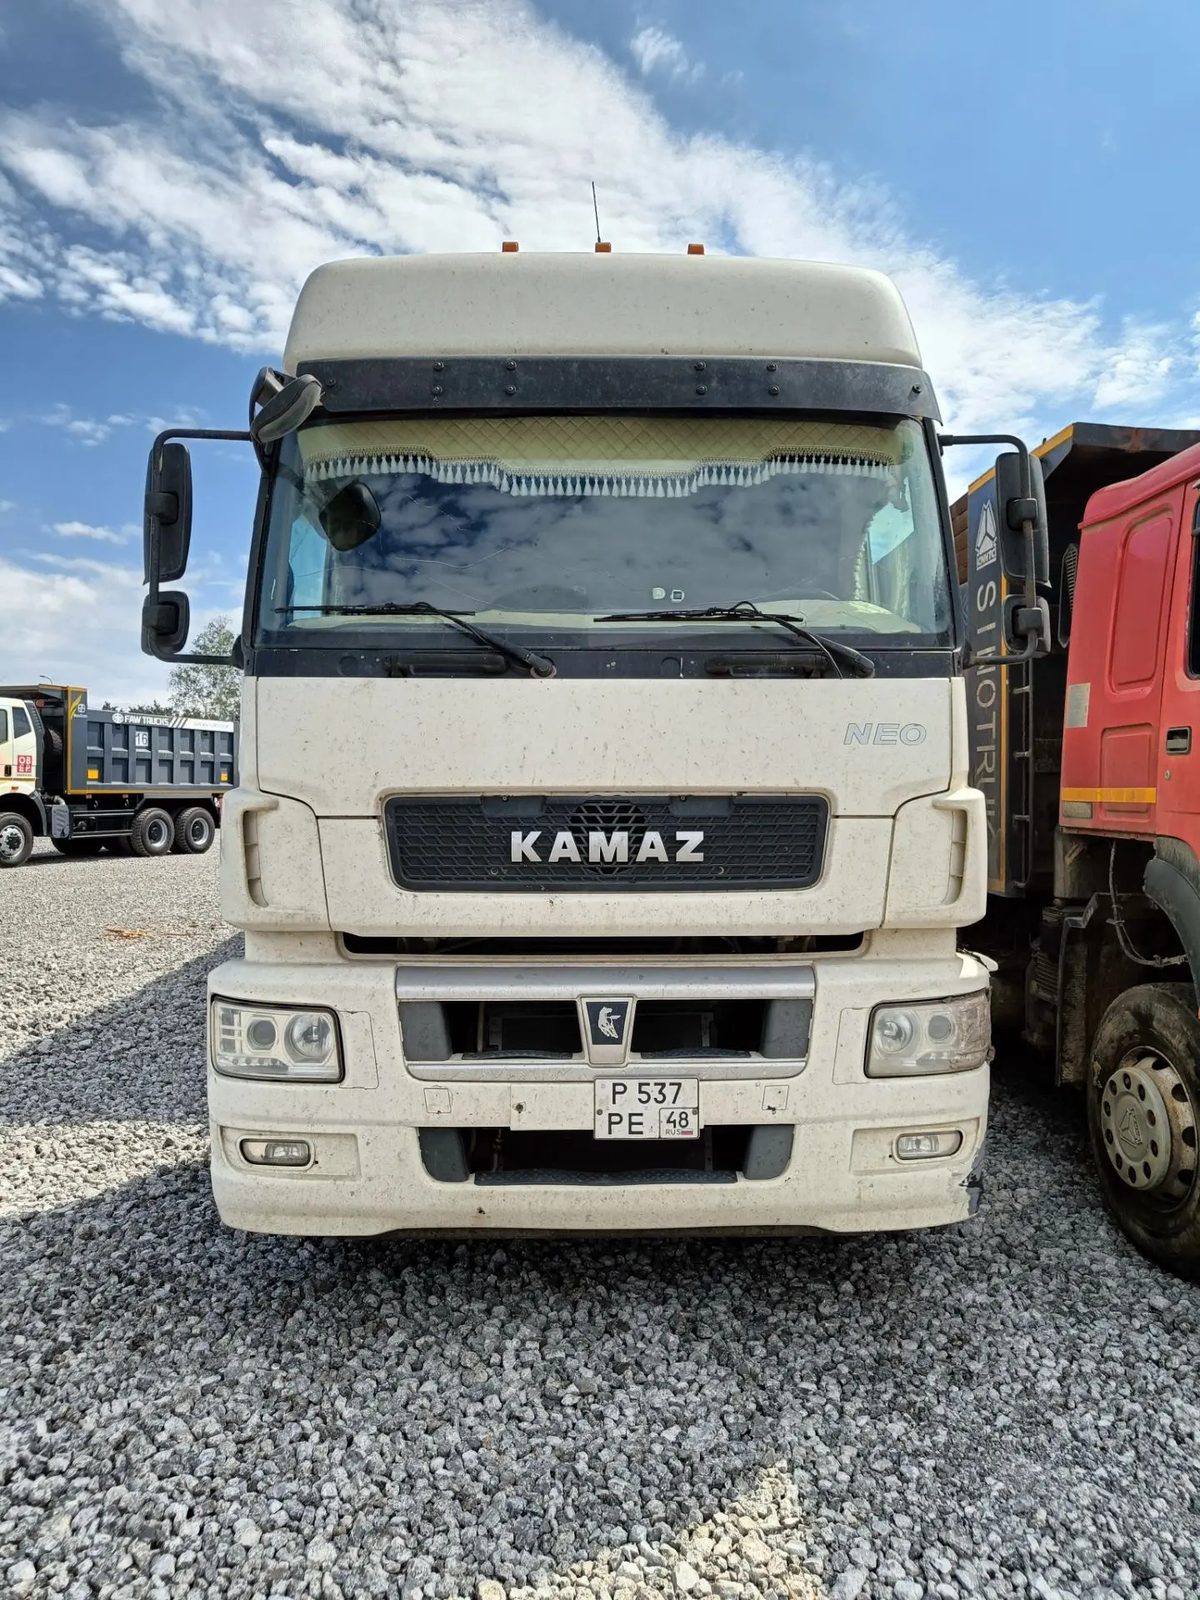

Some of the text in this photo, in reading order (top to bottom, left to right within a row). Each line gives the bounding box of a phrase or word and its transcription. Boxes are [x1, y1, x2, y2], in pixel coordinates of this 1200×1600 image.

[124, 715, 169, 726] FAW TRUCKS
[136, 732, 148, 745] 16
[843, 722, 927, 746] NEO
[511, 831, 704, 862] KAMAZ
[612, 1083, 682, 1104] P 537
[608, 1113, 643, 1135] PE
[666, 1111, 689, 1128] 48
[665, 1128, 681, 1136] RUS
